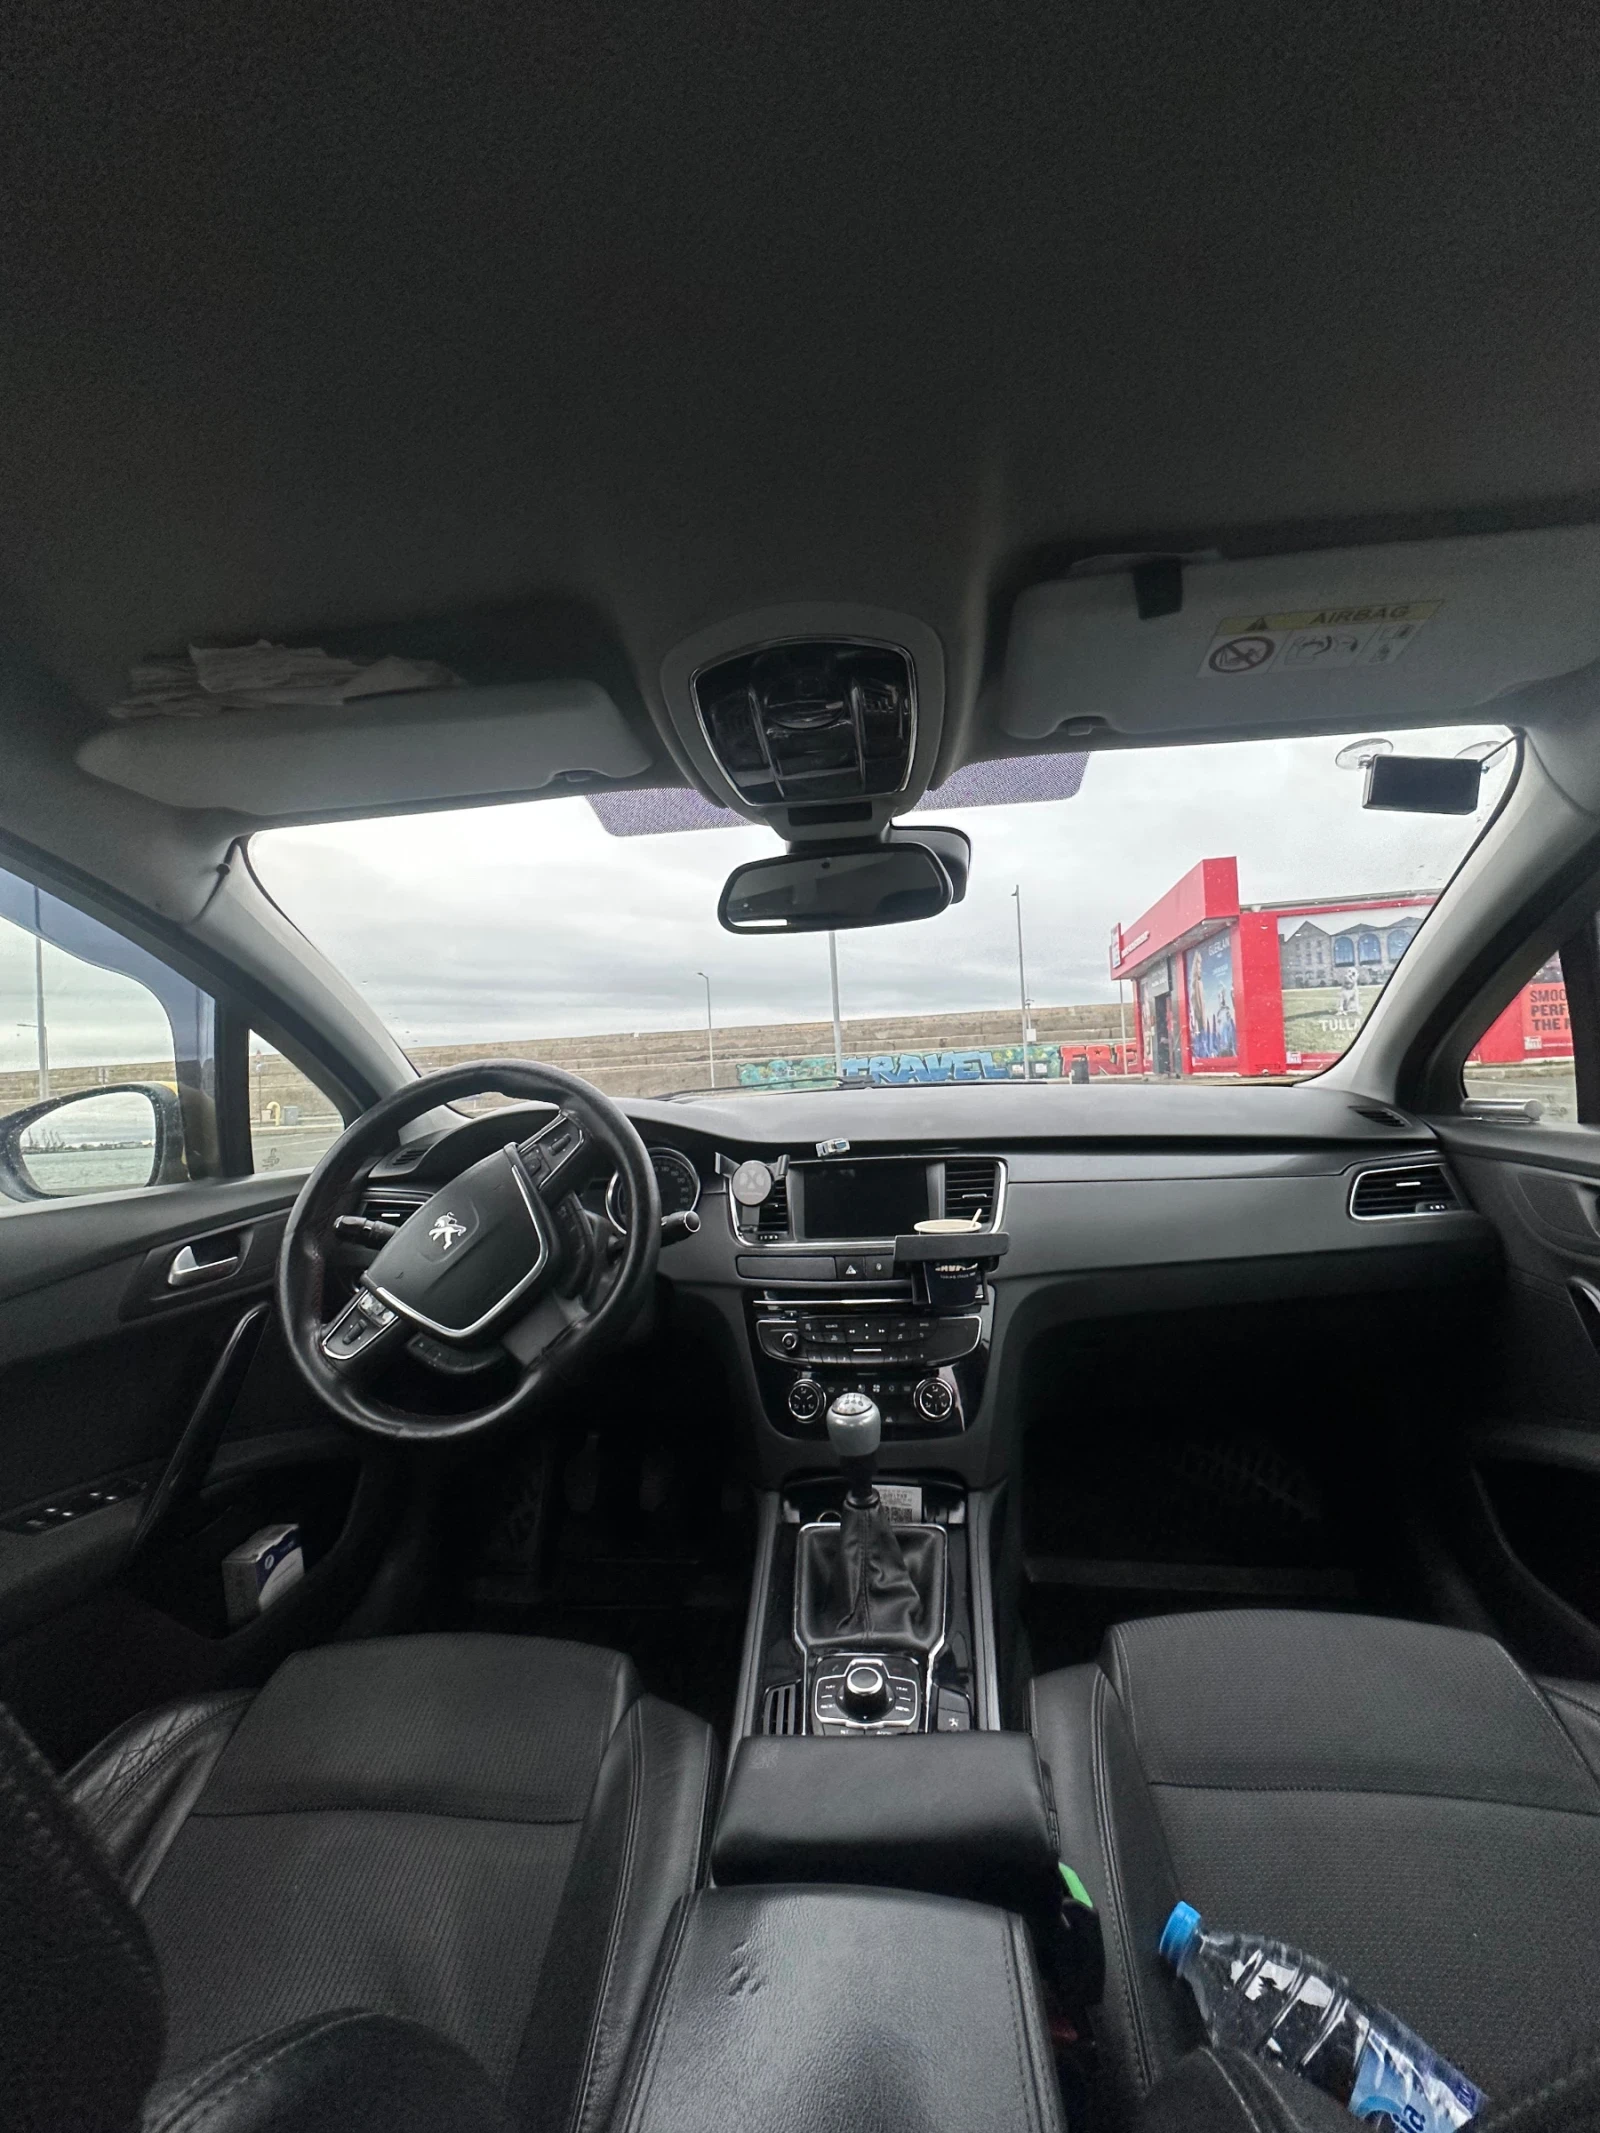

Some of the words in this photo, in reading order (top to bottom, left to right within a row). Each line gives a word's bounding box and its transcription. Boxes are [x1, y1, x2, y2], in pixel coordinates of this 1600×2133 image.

[1309, 606, 1409, 624] AIRBAG
[1532, 1018, 1561, 1031] THE
[840, 1050, 1008, 1084] TRAVEL
